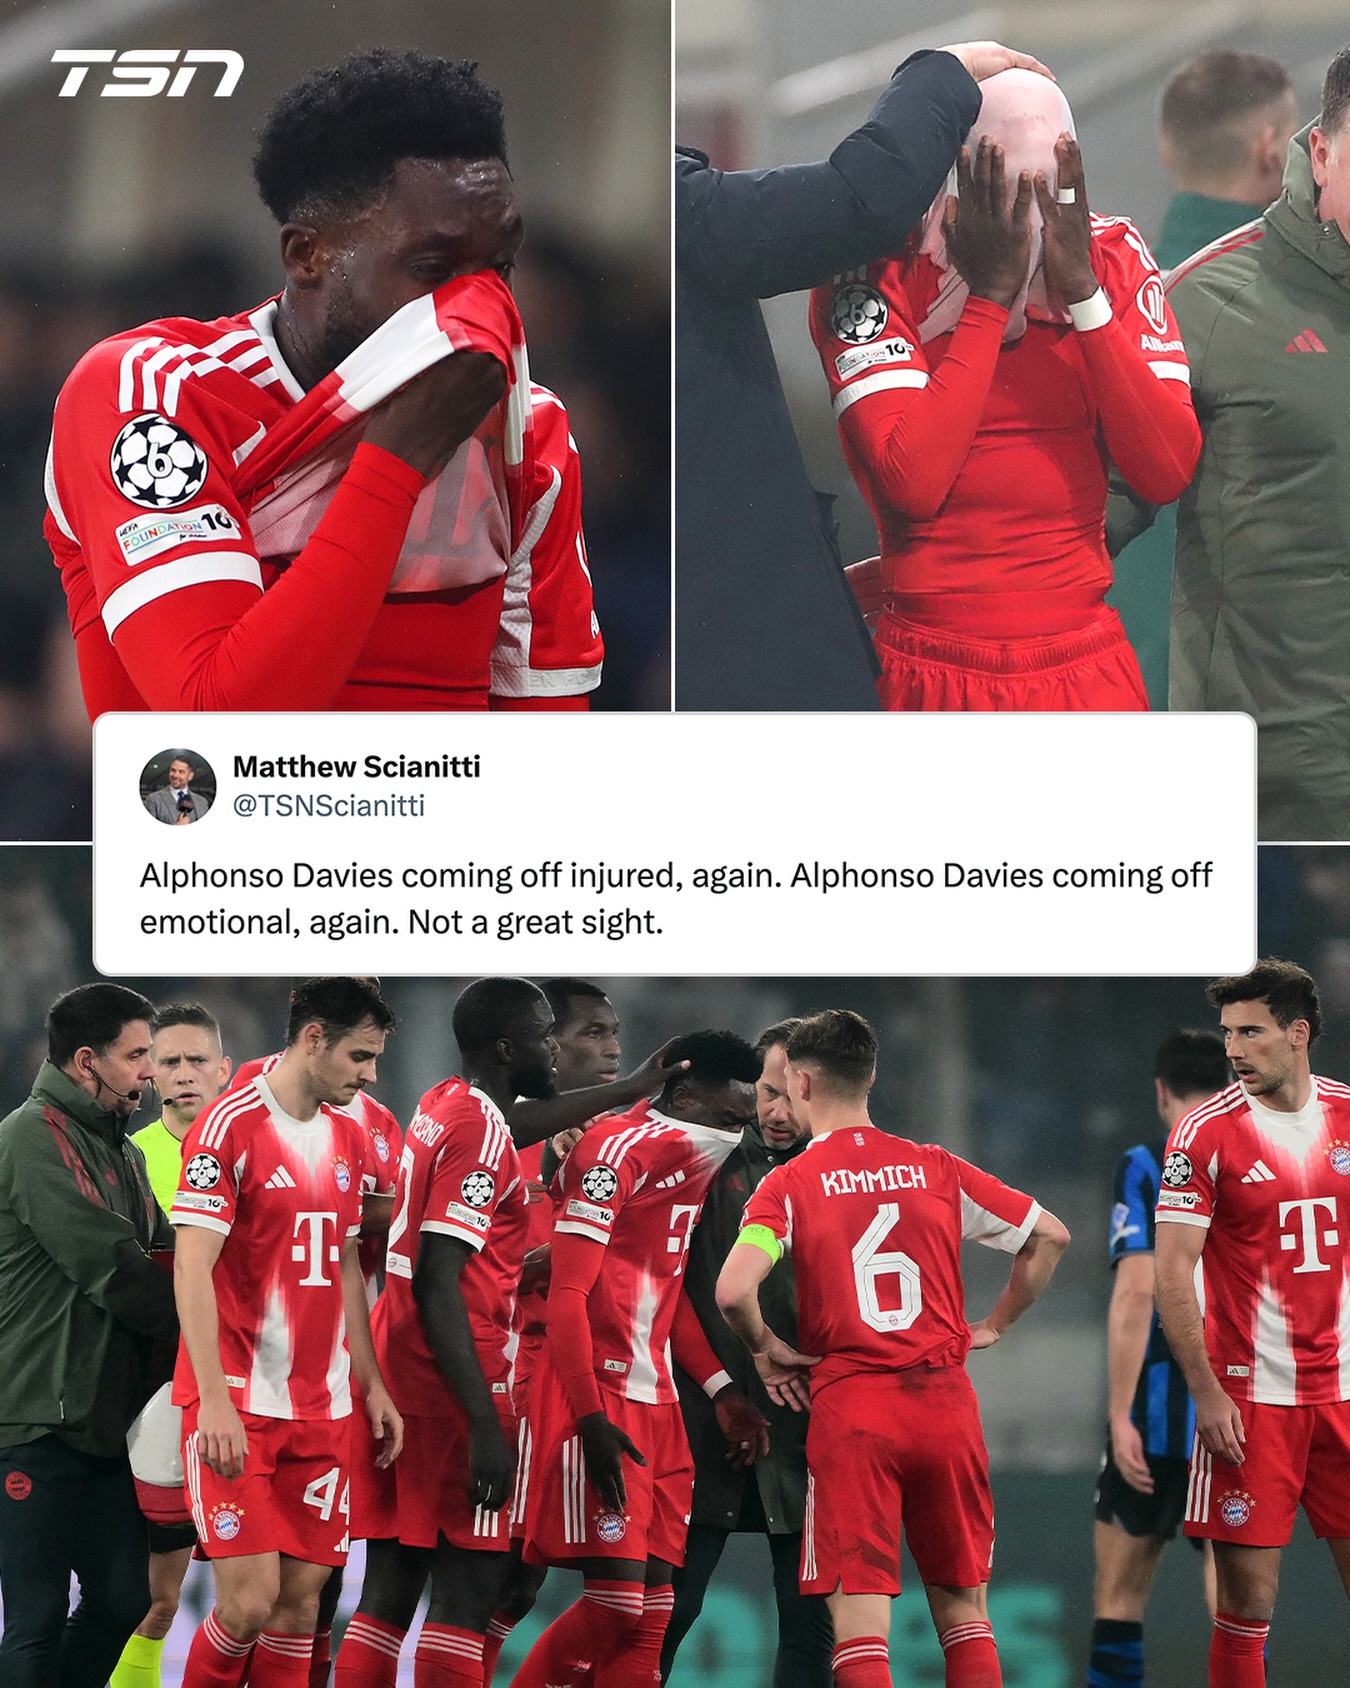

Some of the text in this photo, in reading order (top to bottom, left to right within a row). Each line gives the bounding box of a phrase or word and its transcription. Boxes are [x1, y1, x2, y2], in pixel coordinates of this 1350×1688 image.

[885, 343, 906, 356] 10
[1141, 334, 1185, 353] Allian
[146, 441, 174, 479] 6
[119, 522, 139, 537] UEFA
[123, 521, 203, 551] FOUNDATION
[201, 512, 233, 530] 10
[820, 1164, 927, 1197] KIMMICH
[292, 1212, 340, 1287] T
[1278, 1196, 1340, 1274] T
[851, 1202, 923, 1334] 6
